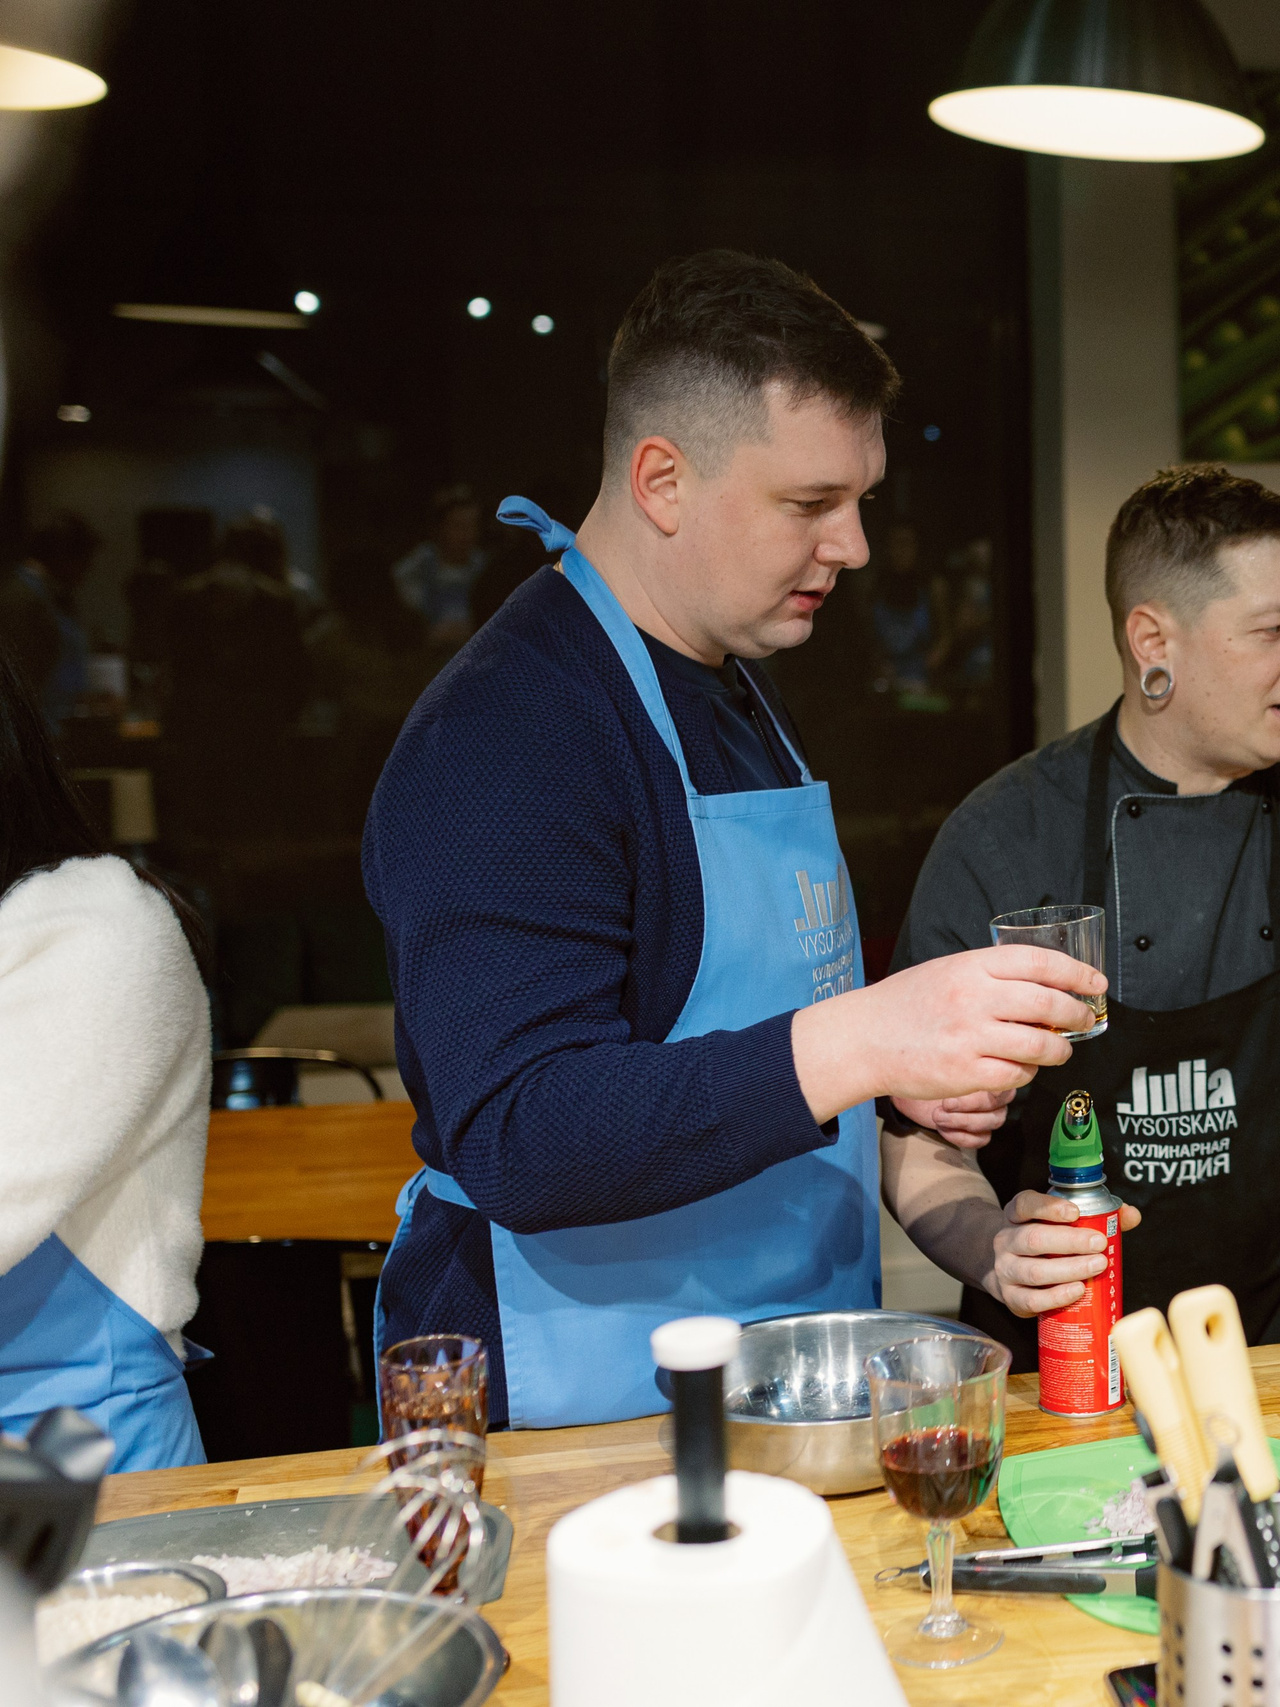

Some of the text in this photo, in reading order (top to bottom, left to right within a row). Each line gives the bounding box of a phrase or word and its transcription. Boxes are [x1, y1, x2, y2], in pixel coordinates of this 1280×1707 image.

[1116, 1058, 1237, 1116] Julia
[1116, 1109, 1239, 1138] VYSOTSKAYA
[1124, 1137, 1231, 1160] КУЛИНАРНАЯ
[1123, 1152, 1231, 1187] СТУДИЯ
